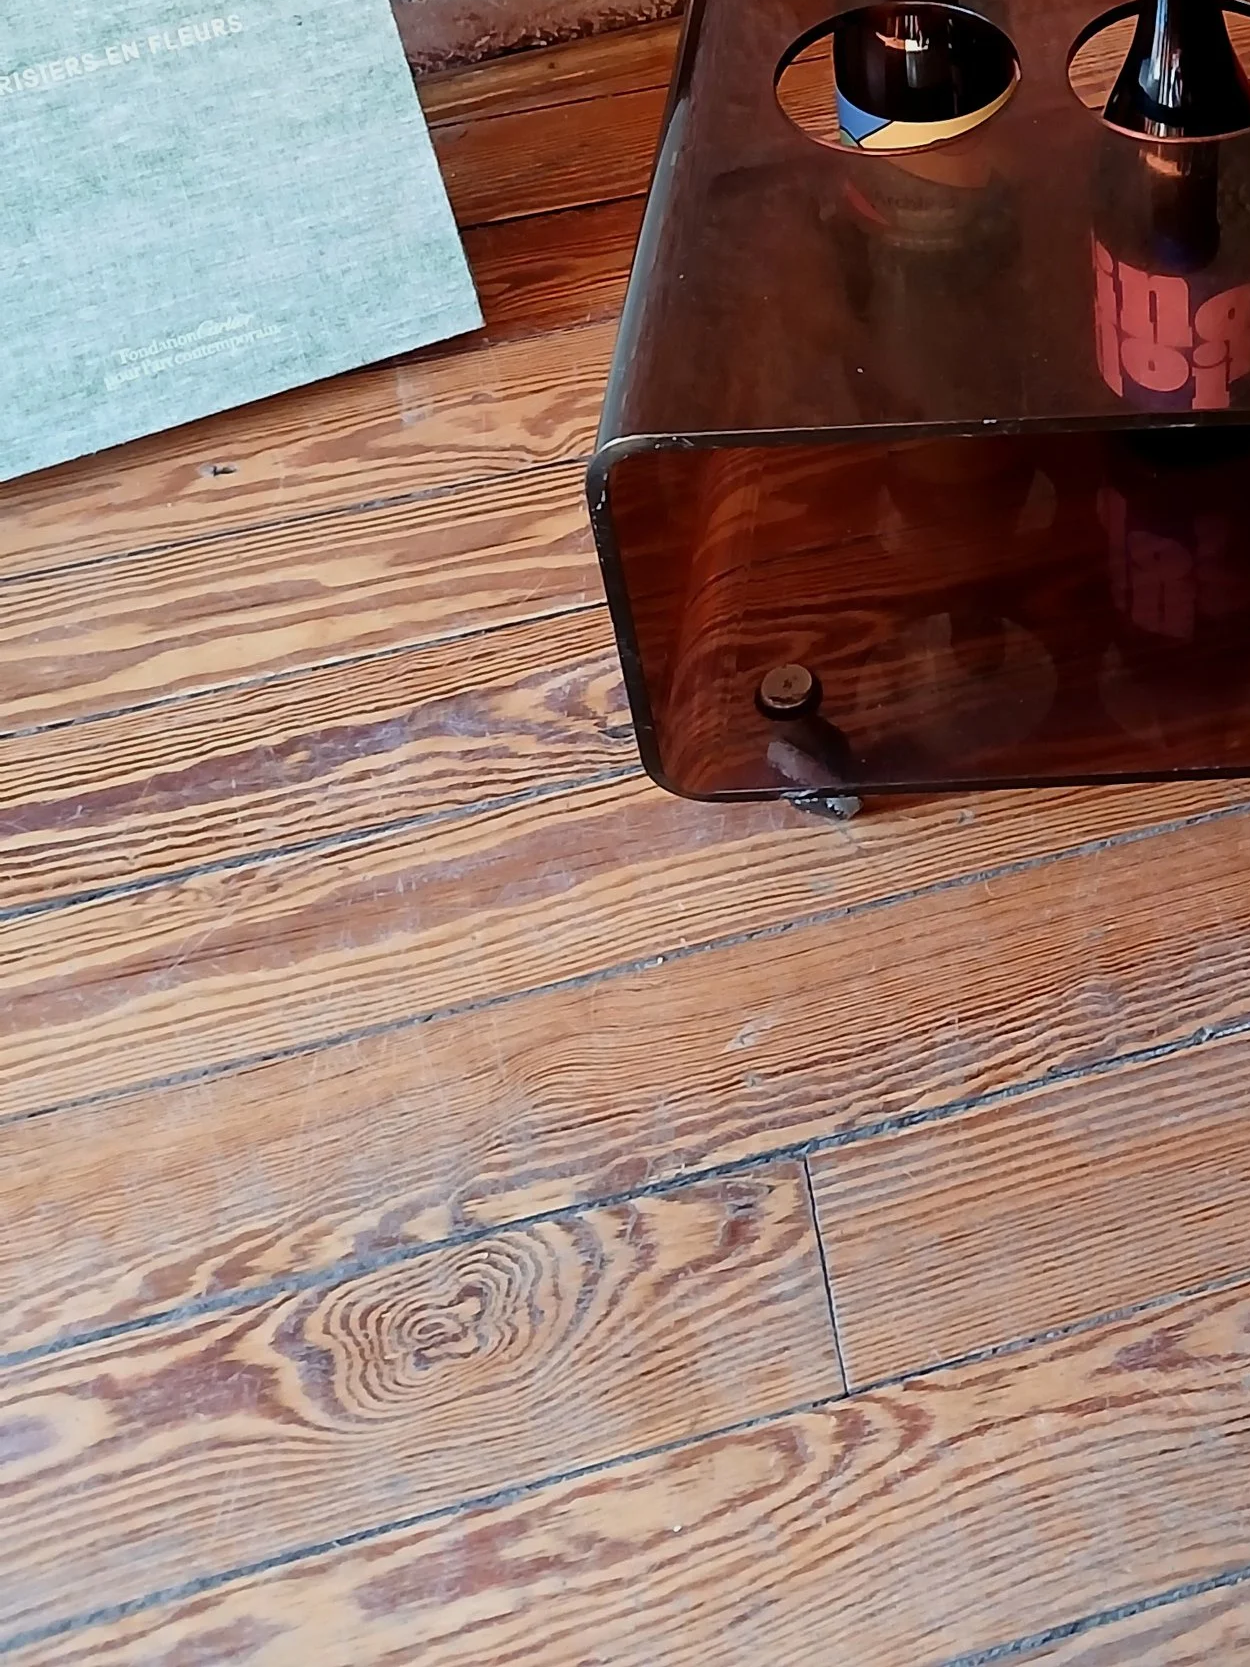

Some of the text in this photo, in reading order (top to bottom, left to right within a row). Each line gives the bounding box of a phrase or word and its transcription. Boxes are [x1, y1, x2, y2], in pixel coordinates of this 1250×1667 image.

[104, 41, 140, 66] EN
[148, 14, 244, 54] FLEURS
[118, 331, 199, 365] Fondation
[174, 324, 282, 365] contemporain
